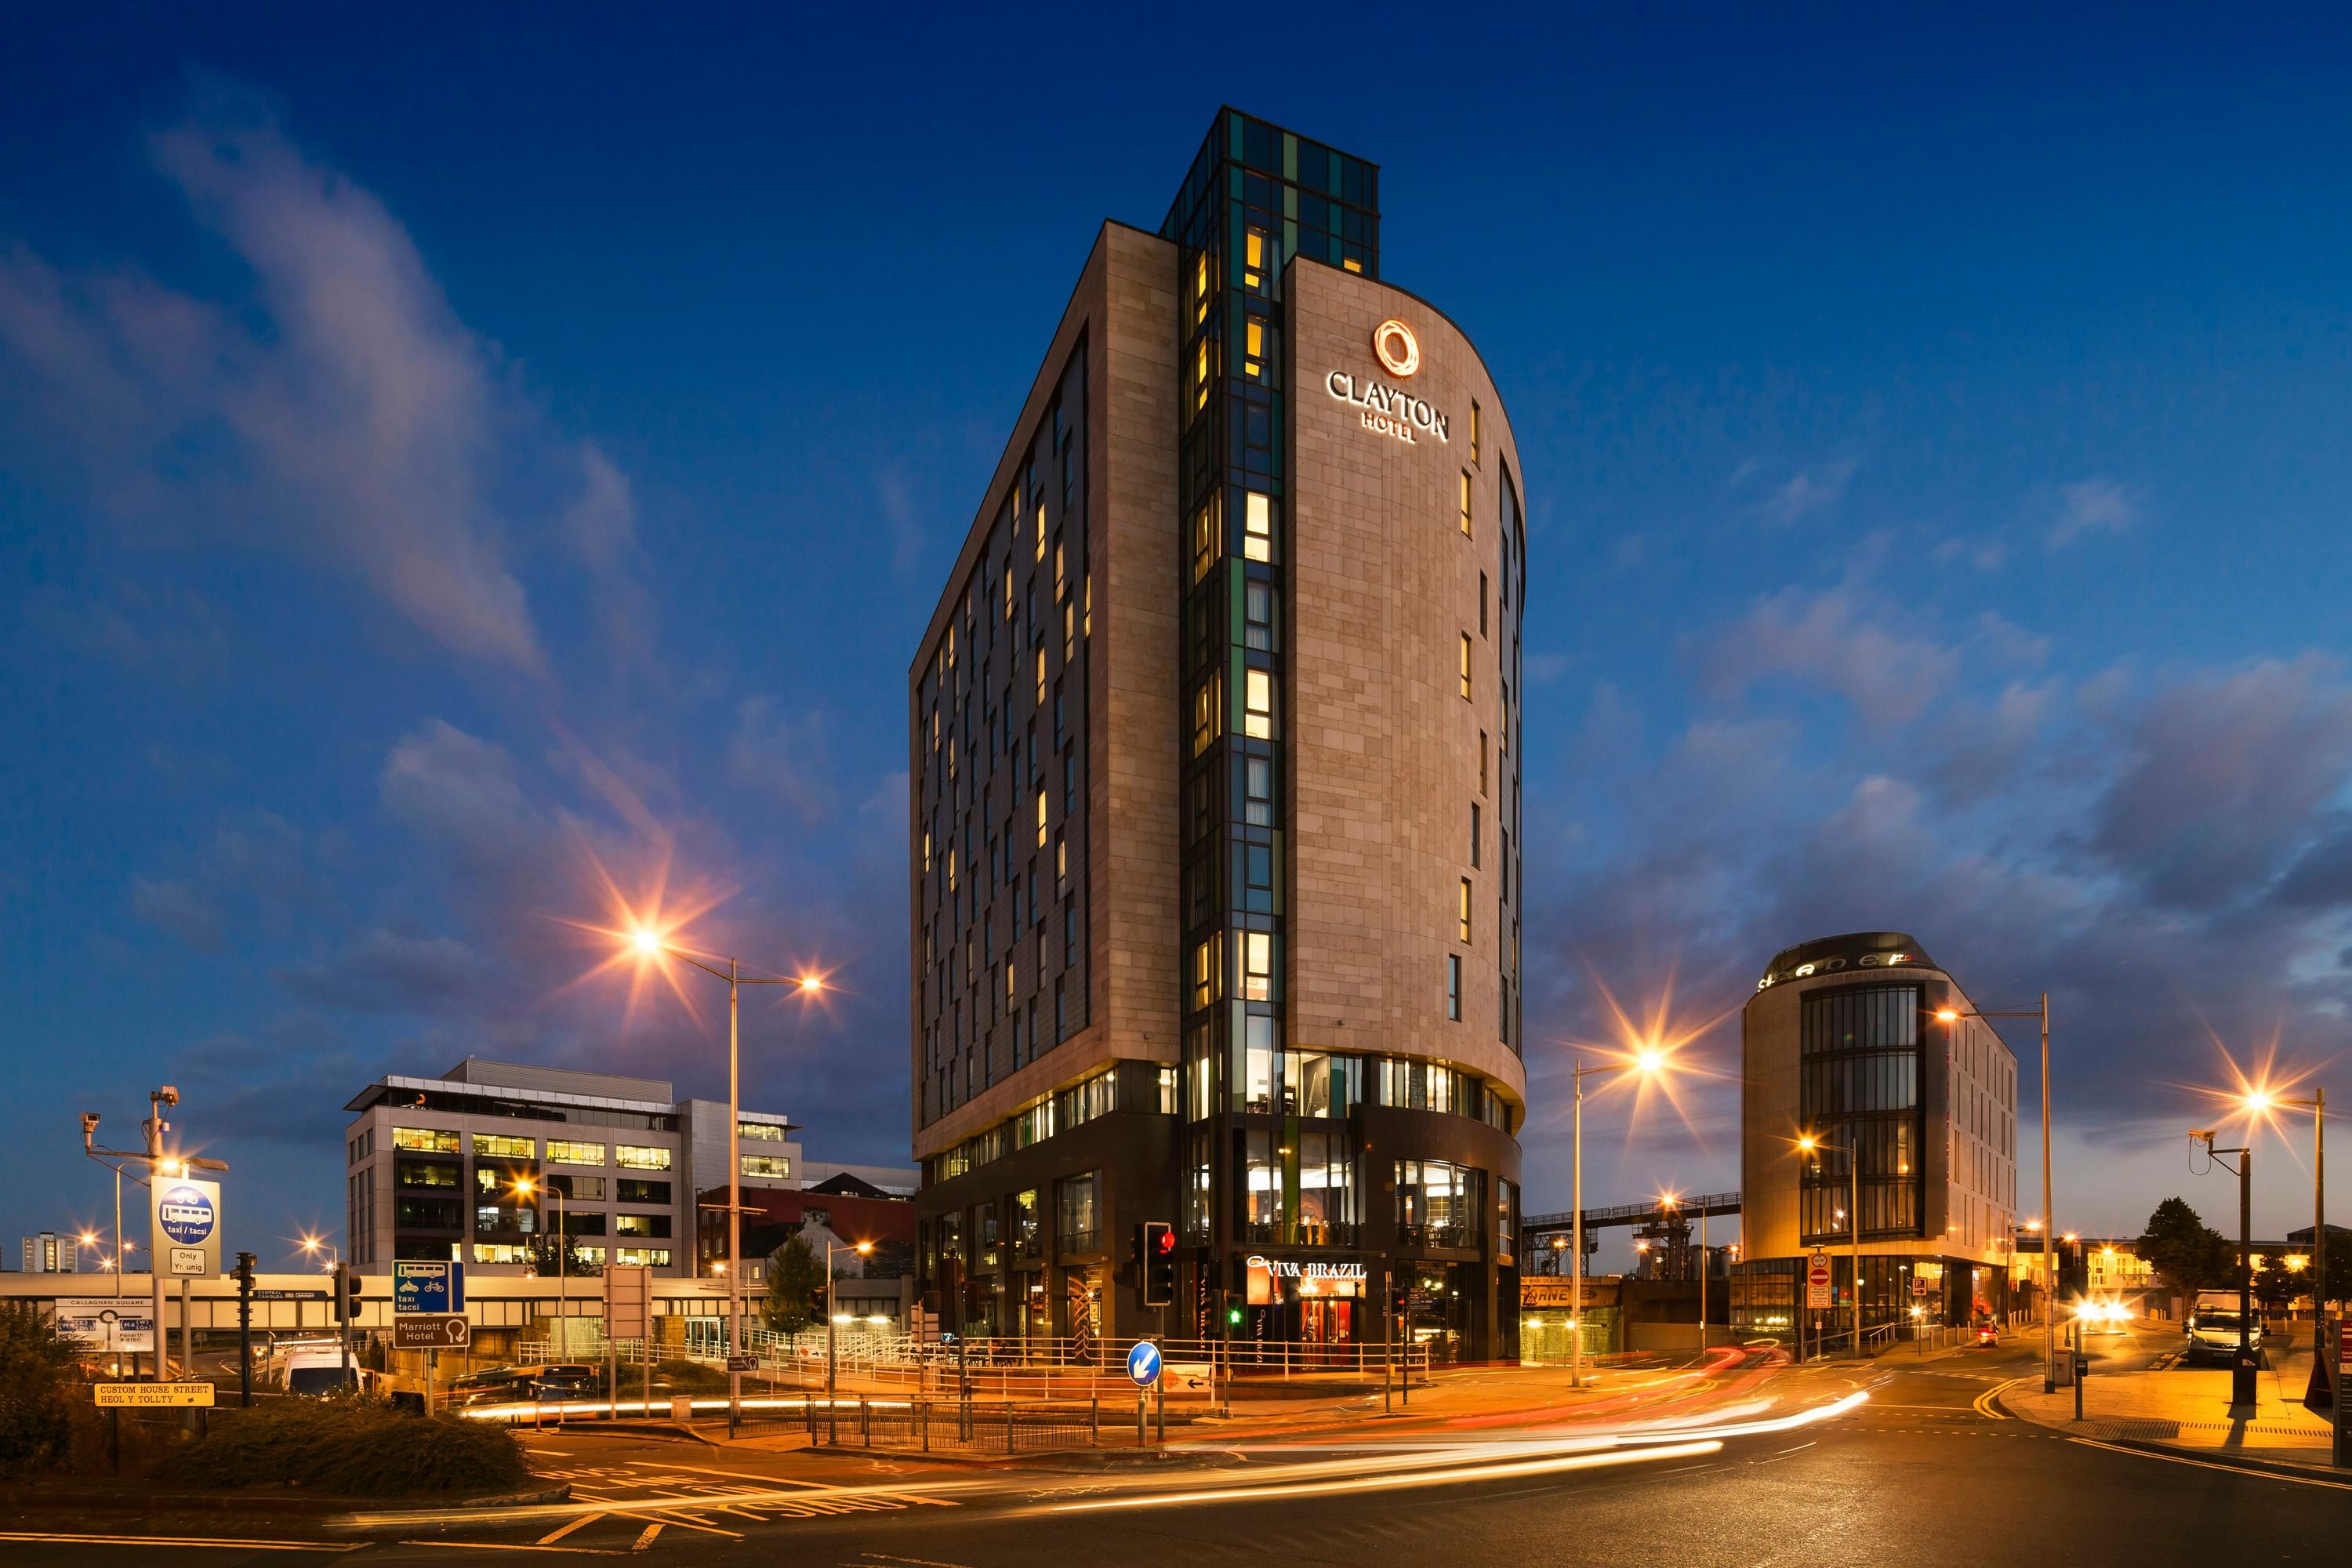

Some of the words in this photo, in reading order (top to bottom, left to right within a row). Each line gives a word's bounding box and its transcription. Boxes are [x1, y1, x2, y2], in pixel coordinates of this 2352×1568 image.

[1327, 371, 1449, 441] CLAYTON
[1362, 412, 1417, 444] HOTEL
[1247, 1256, 1303, 1276] VIVA
[1308, 1263, 1367, 1277] BRAZIL
